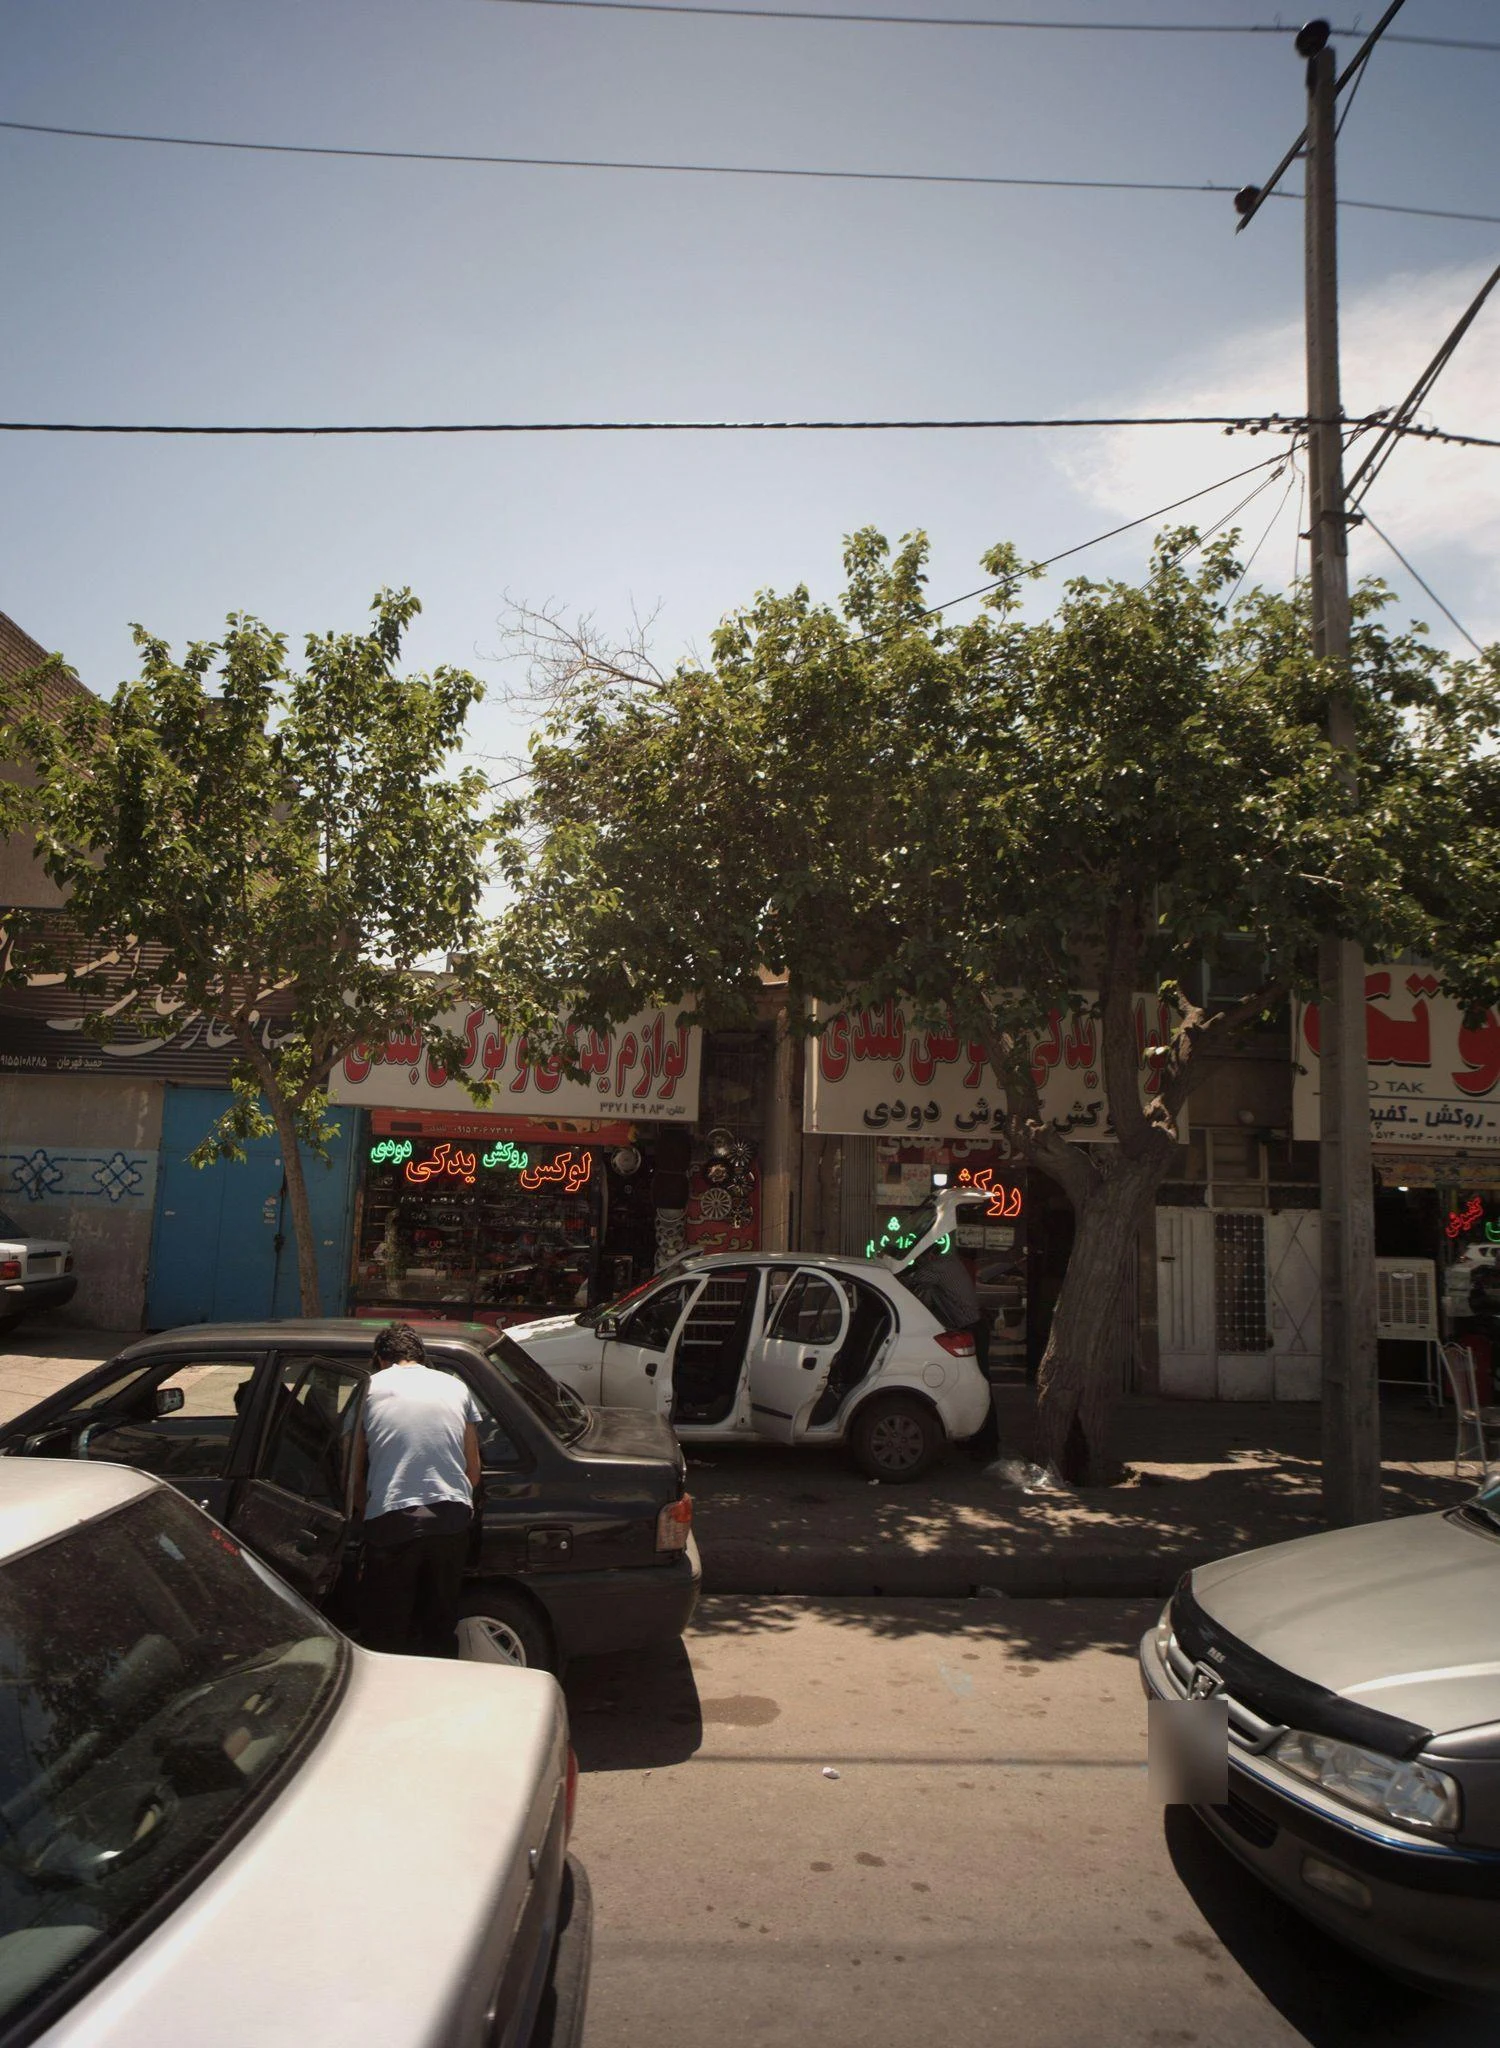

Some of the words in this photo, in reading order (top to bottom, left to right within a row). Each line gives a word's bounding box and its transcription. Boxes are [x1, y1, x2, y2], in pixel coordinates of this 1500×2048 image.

[615, 1011, 691, 1099] لوازم
[1386, 1080, 1424, 1093] TAK
[863, 1099, 940, 1130] دودی
[1426, 1104, 1484, 1128] روکش
[371, 1139, 412, 1164] دودی
[406, 1143, 477, 1183] یدکی
[482, 1140, 529, 1170] روکش
[520, 1151, 592, 1192] لوکس
